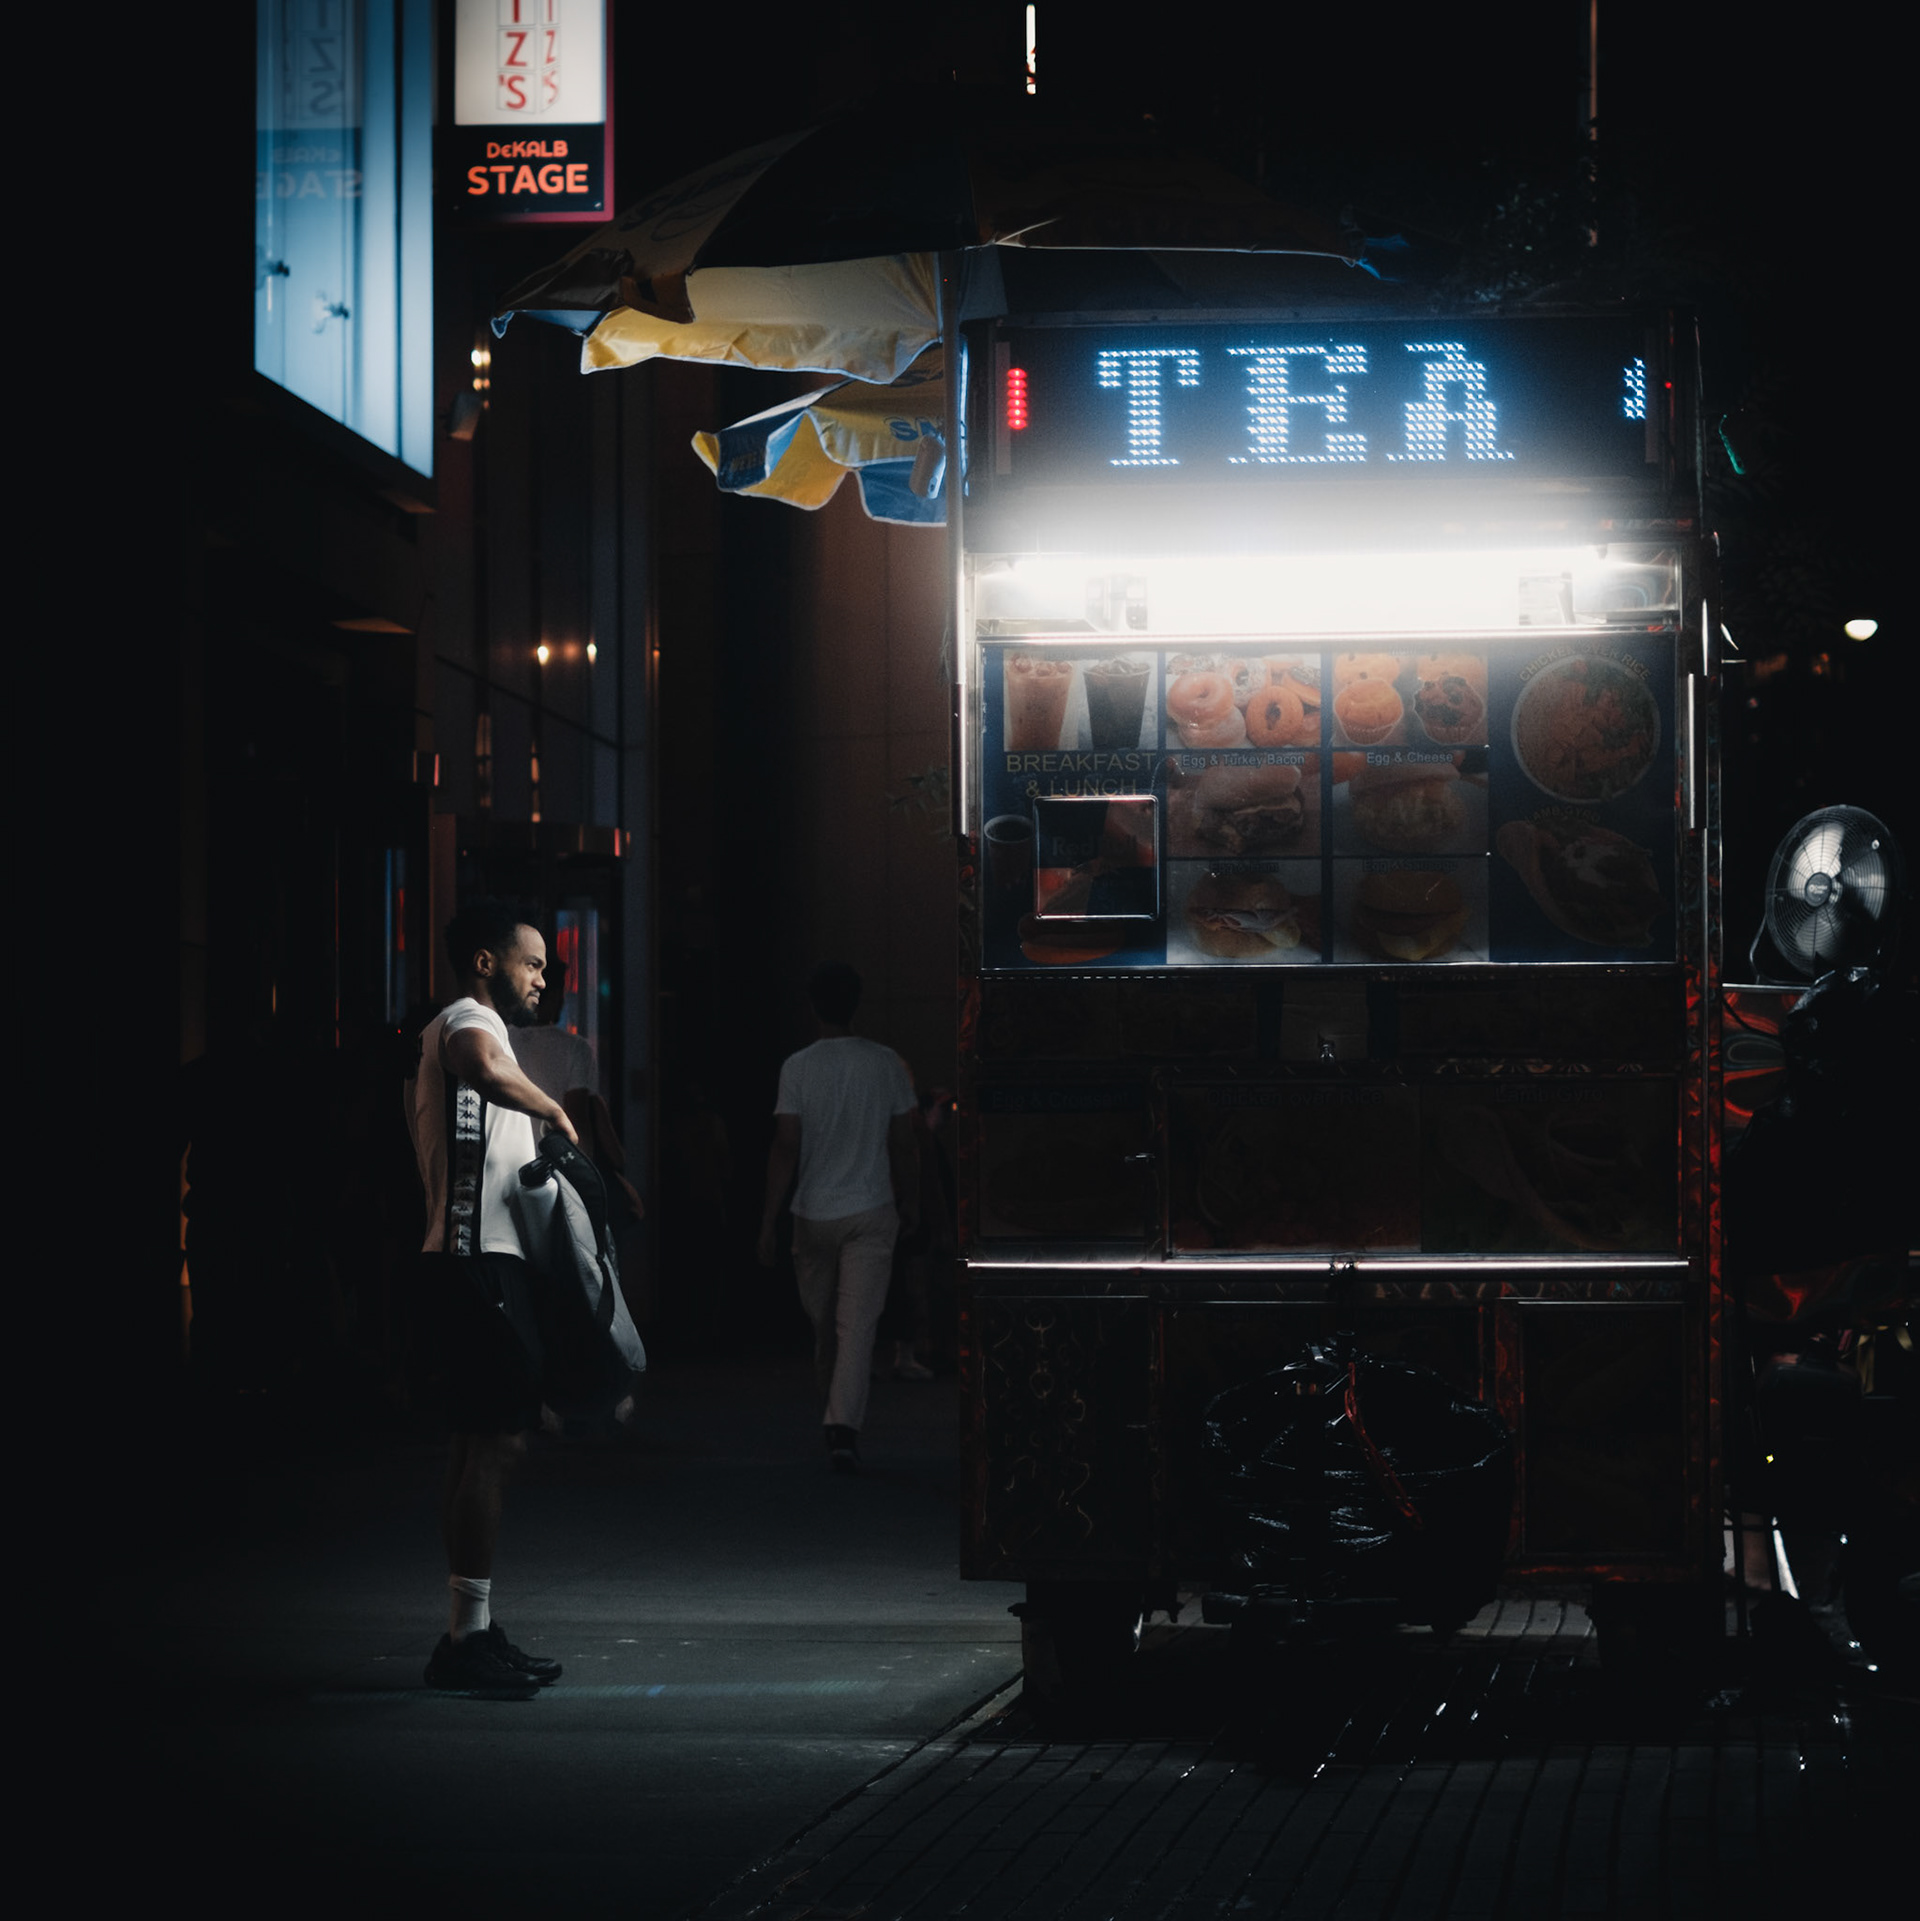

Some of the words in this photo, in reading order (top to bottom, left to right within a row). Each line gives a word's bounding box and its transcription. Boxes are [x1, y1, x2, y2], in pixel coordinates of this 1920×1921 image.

[467, 163, 589, 195] STAGE
[1097, 341, 1516, 467] TEA
[1621, 652, 1652, 681] RICE
[1006, 753, 1157, 773] BREAKFAST
[1182, 754, 1206, 769] Egg
[1210, 754, 1219, 766] &
[1223, 753, 1264, 768] Turkey
[1266, 753, 1305, 766] Bacon
[1366, 752, 1389, 766] Egg
[1393, 752, 1403, 764] &
[1407, 751, 1454, 764] Cheese
[1026, 779, 1040, 797] &
[1050, 778, 1137, 797] LUNCH
[1362, 858, 1387, 873] Egg
[1340, 1088, 1383, 1105] Rice
